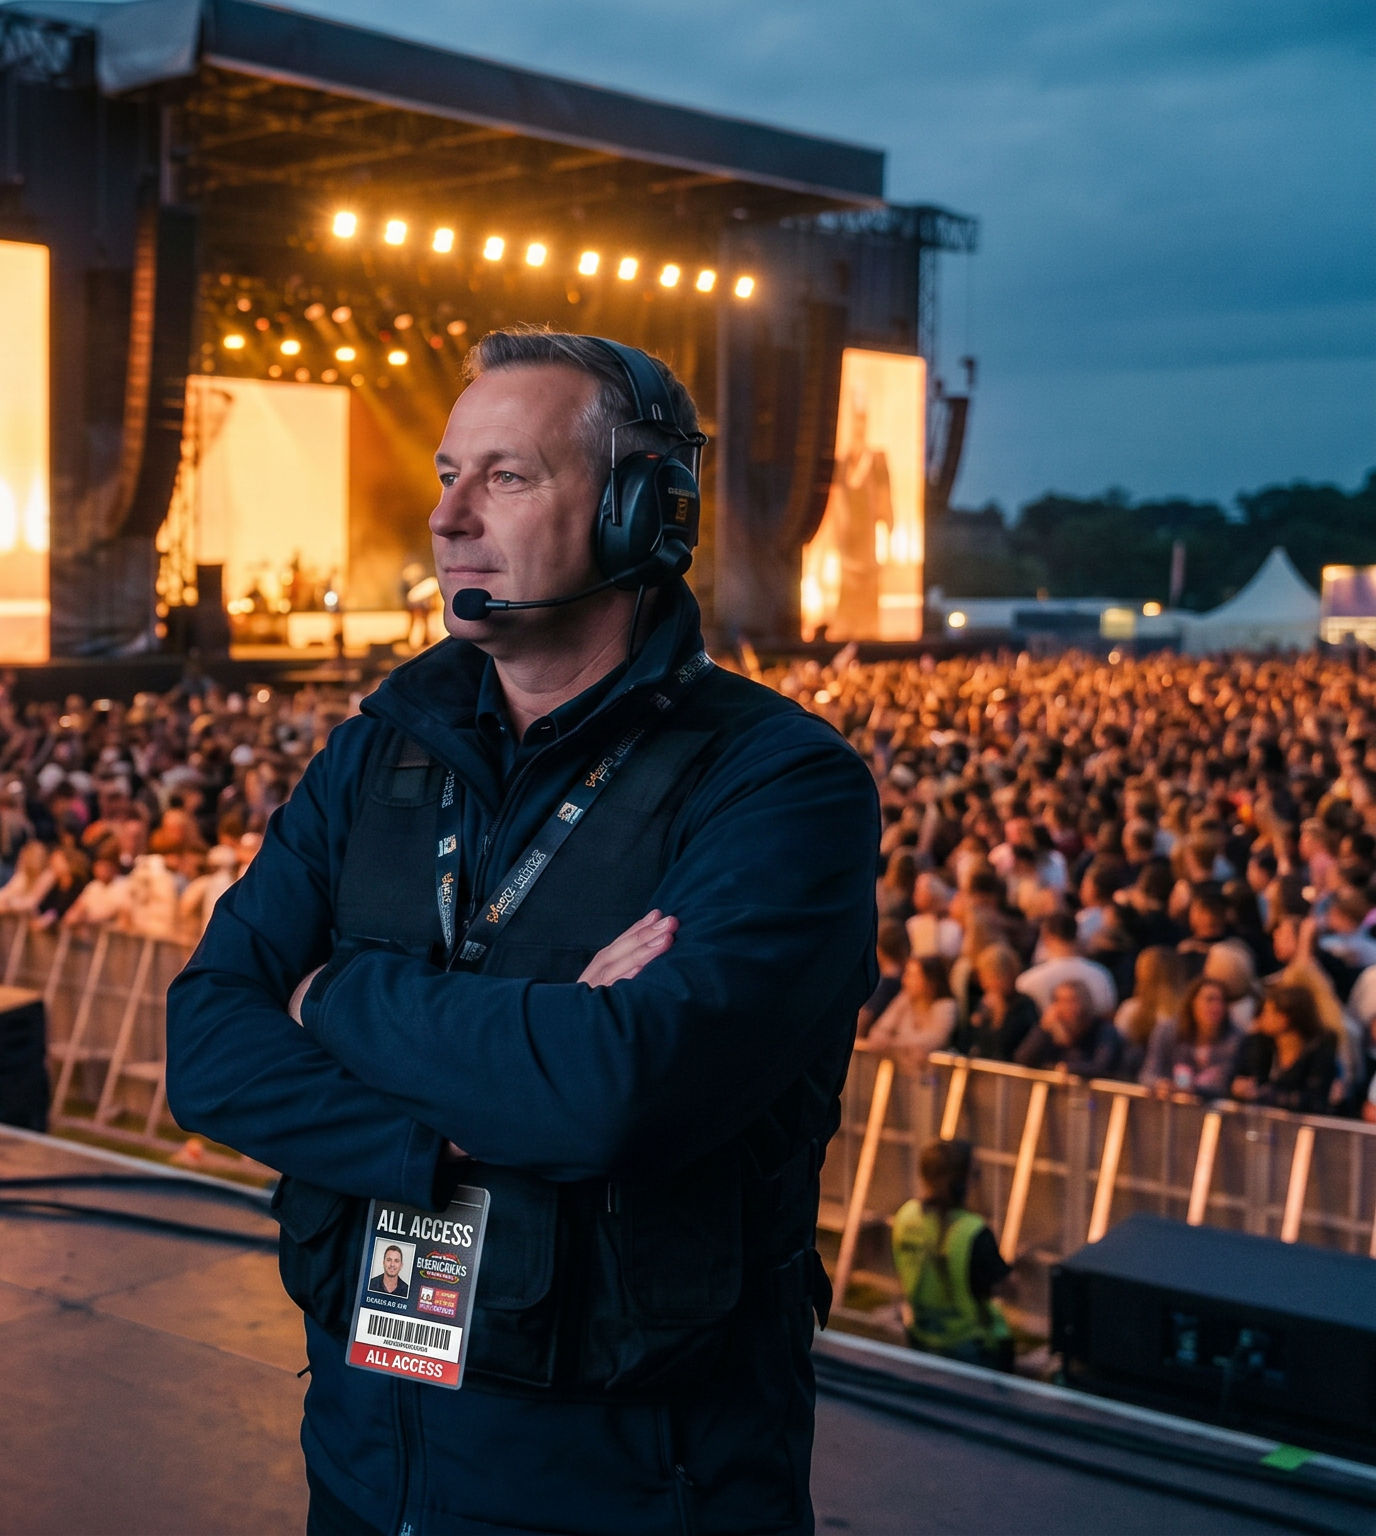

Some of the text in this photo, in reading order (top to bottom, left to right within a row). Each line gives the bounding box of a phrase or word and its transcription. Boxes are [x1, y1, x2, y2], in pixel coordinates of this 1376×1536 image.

[377, 1209, 474, 1248] ALL ACCESS
[365, 1350, 444, 1378] ALL ACCESS
